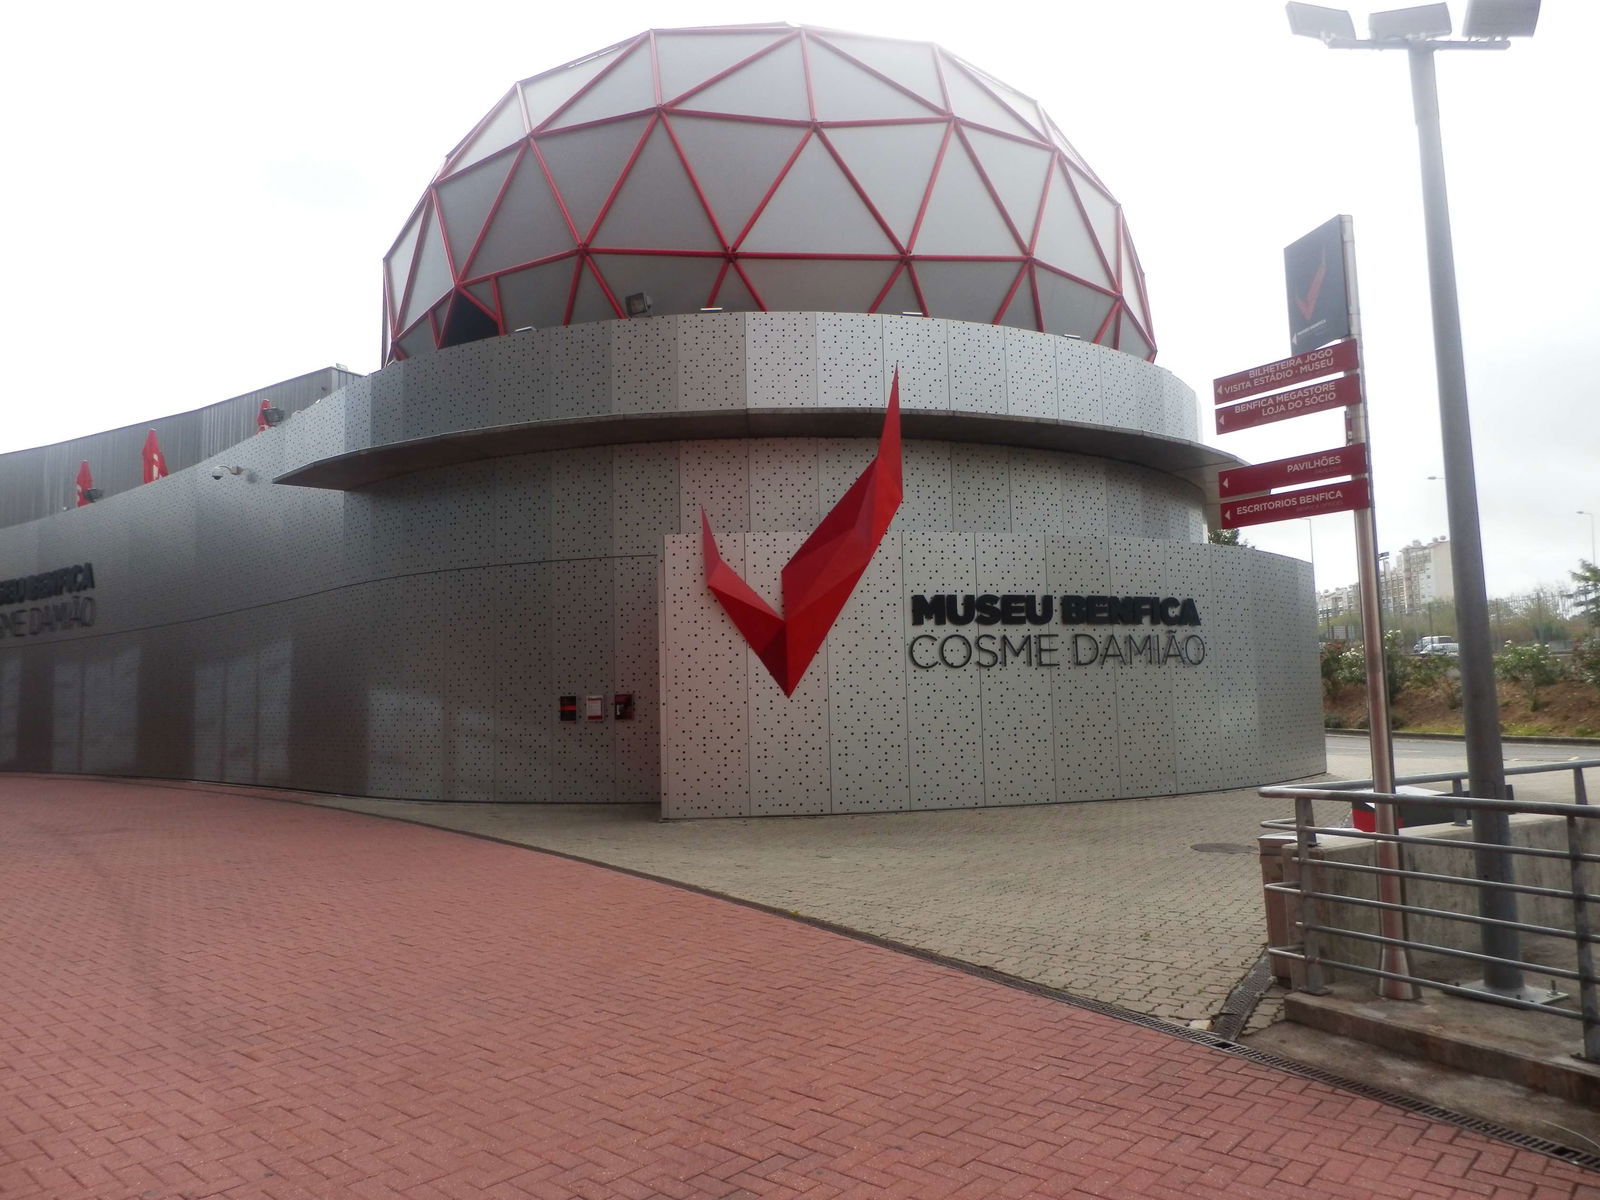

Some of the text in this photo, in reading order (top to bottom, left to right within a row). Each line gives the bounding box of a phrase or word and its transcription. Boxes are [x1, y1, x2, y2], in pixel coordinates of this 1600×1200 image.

[1224, 357, 1334, 394] VISITA ESTÁDIO MUSEU
[1248, 348, 1333, 379] BILHETEIRA JOGO
[1234, 382, 1336, 414] BENFICA MEGASTORE
[1261, 392, 1337, 417] LOJA DO SÓCIO
[1286, 455, 1342, 473] PAVILHÕES
[1299, 489, 1343, 505] BENFICA
[911, 594, 1201, 627] MUSEU BENFICA
[908, 630, 1206, 669] COSME DAMIÃO
